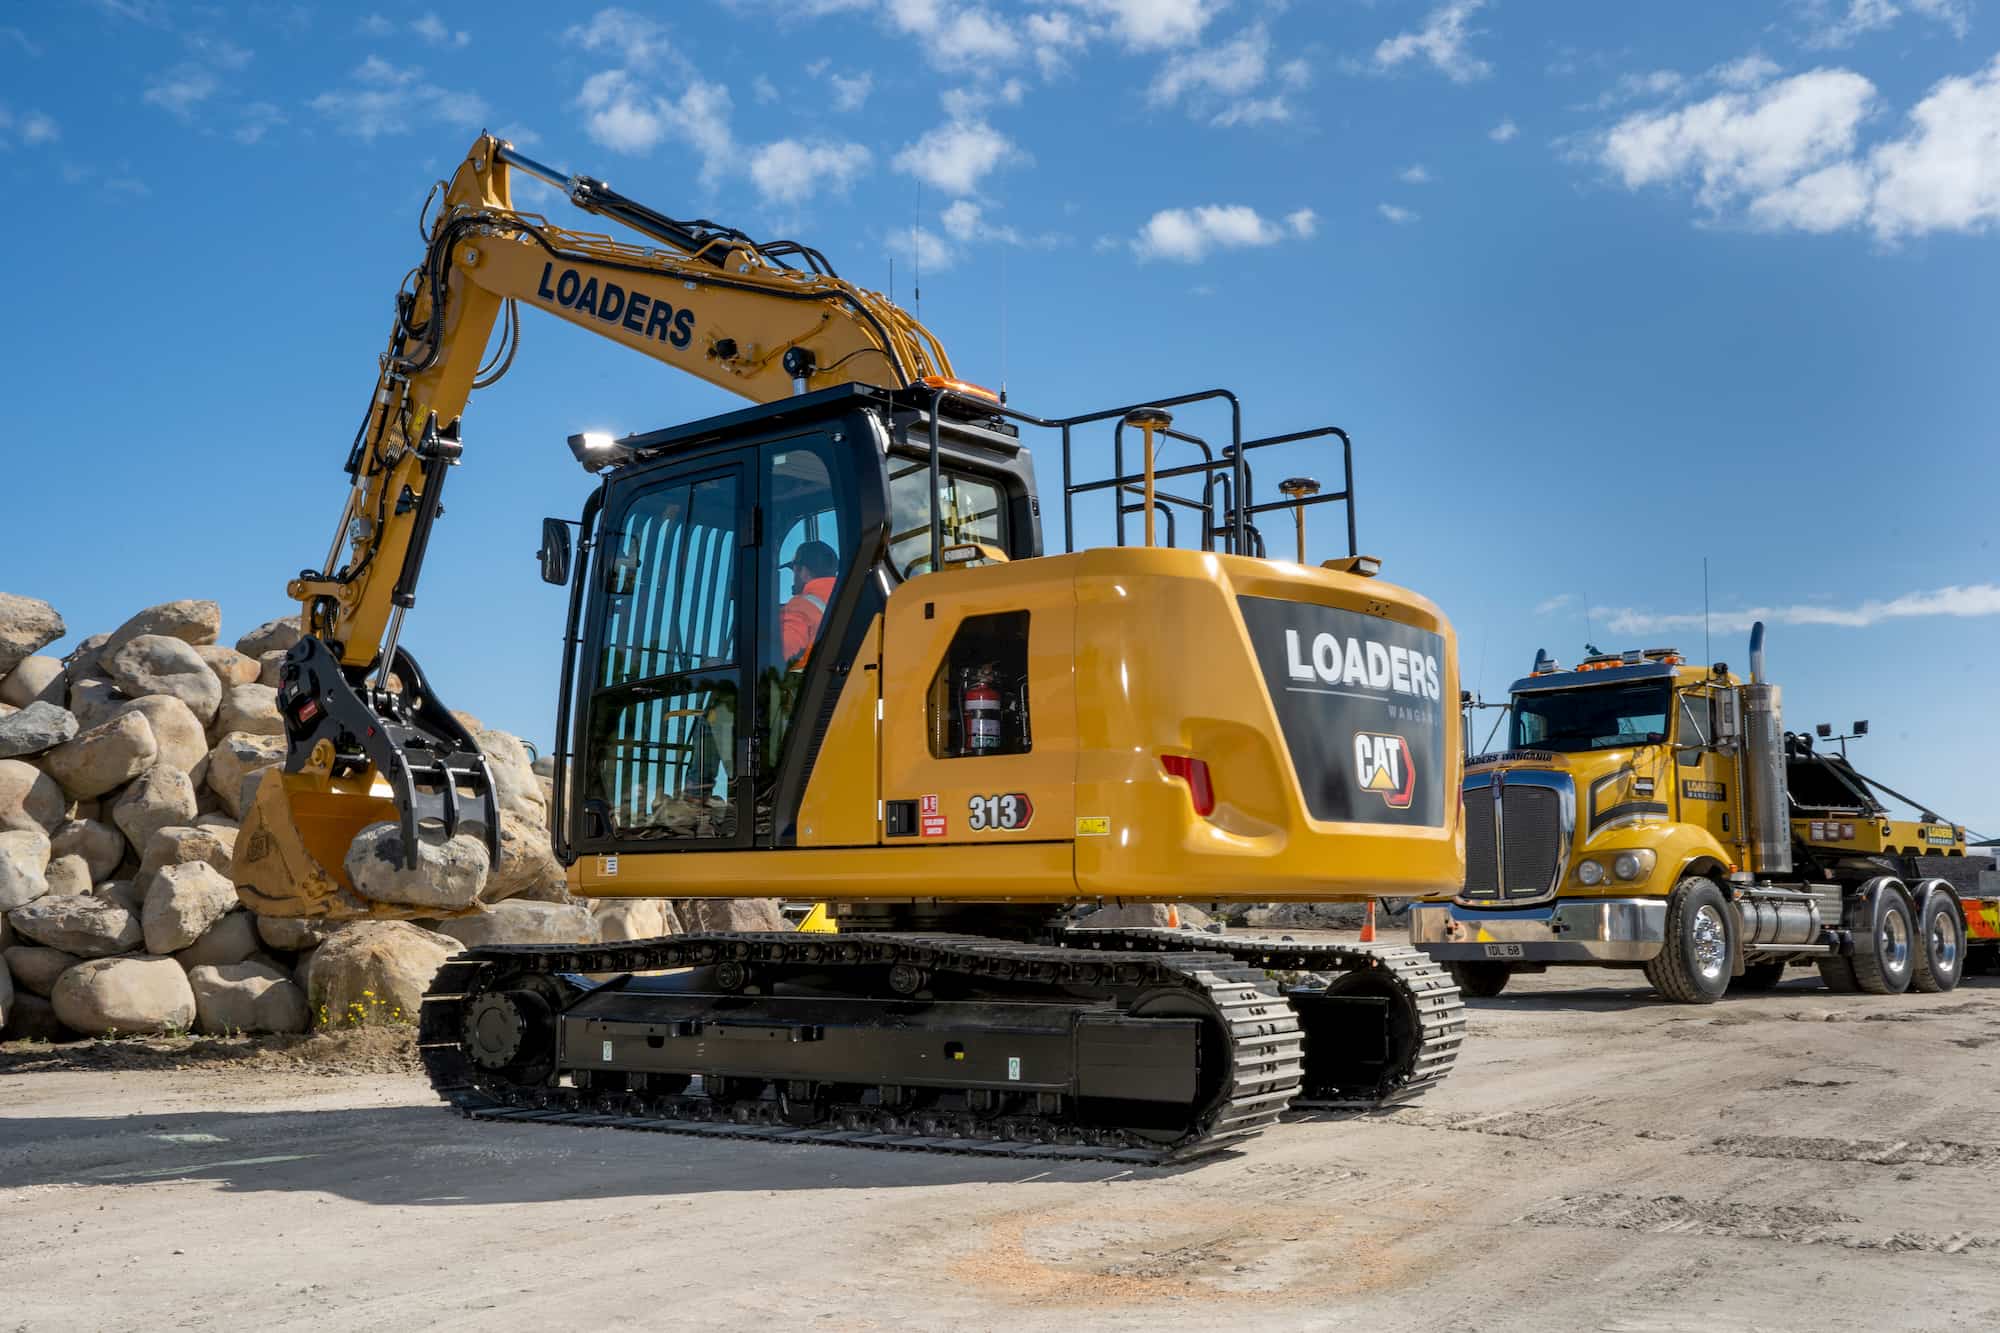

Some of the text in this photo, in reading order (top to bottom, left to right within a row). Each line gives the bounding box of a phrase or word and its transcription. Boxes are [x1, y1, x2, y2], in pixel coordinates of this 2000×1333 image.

[537, 262, 696, 350] LOADERS
[1285, 629, 1440, 700] LOADERS
[1387, 704, 1440, 727] WANGAN
[1354, 734, 1401, 790] CAT
[1464, 754, 1498, 767] OADERS
[969, 794, 1017, 829] 313
